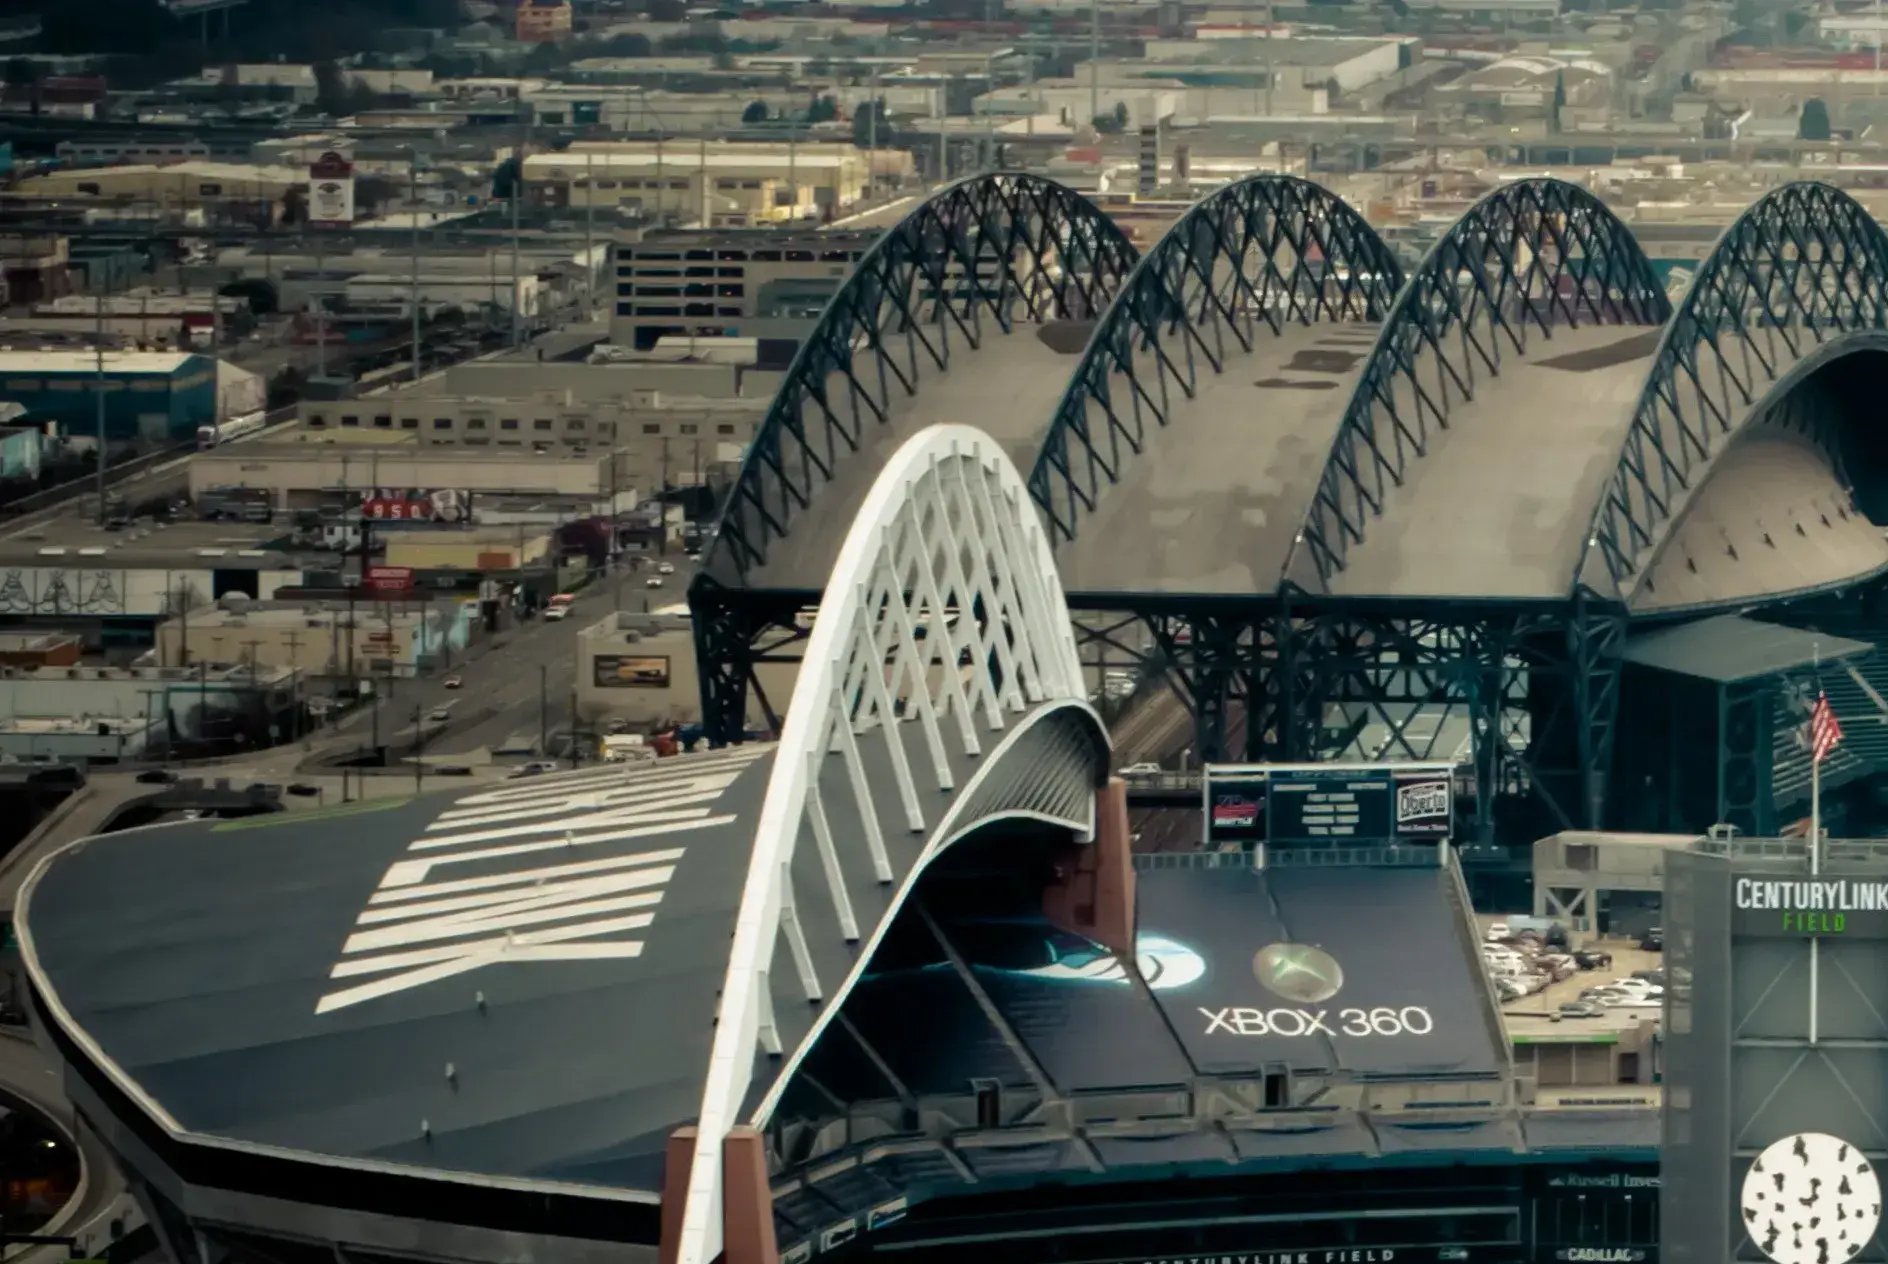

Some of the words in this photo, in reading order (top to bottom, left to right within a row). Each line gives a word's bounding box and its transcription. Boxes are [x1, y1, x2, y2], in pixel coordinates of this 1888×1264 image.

[1783, 911, 1846, 932] FIELD
[1197, 1006, 1337, 1037] XBOX
[1339, 1005, 1433, 1037] 360
[1326, 1249, 1395, 1263] FIELD
[1567, 1248, 1632, 1262] CADILLAC
